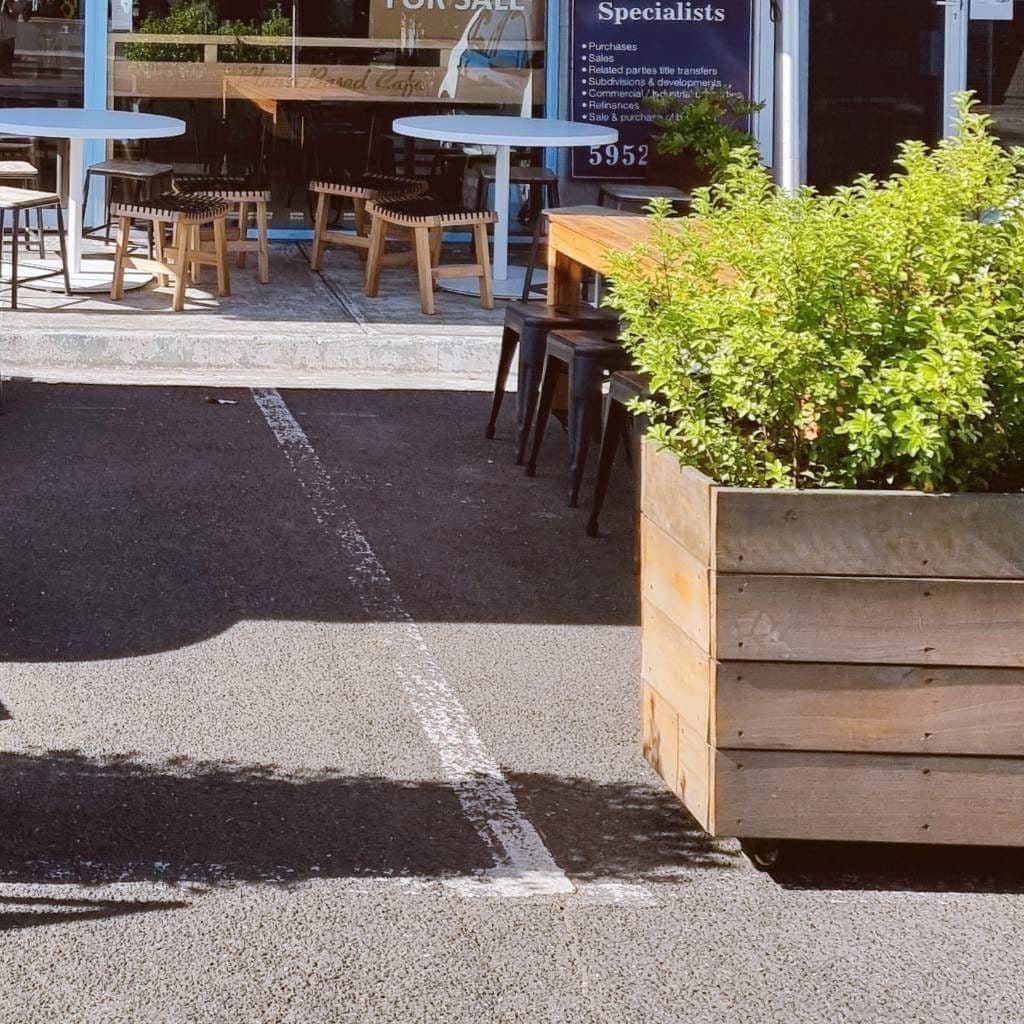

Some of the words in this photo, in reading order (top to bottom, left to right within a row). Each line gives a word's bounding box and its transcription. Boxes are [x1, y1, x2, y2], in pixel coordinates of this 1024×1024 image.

[598, 1, 725, 24] Specialists
[589, 42, 638, 51] Purchases
[589, 54, 615, 63] Sales
[589, 65, 623, 74] Related
[625, 66, 657, 76] parties
[659, 66, 675, 75] title
[677, 66, 717, 75] transfers
[589, 77, 646, 86] Subdivisions
[648, 77, 655, 86] &
[657, 77, 722, 88] developments
[589, 88, 643, 98] Commercial
[589, 100, 640, 110] Refinances
[589, 112, 609, 121] Sale
[611, 112, 618, 121] &
[588, 145, 649, 166] 5952
